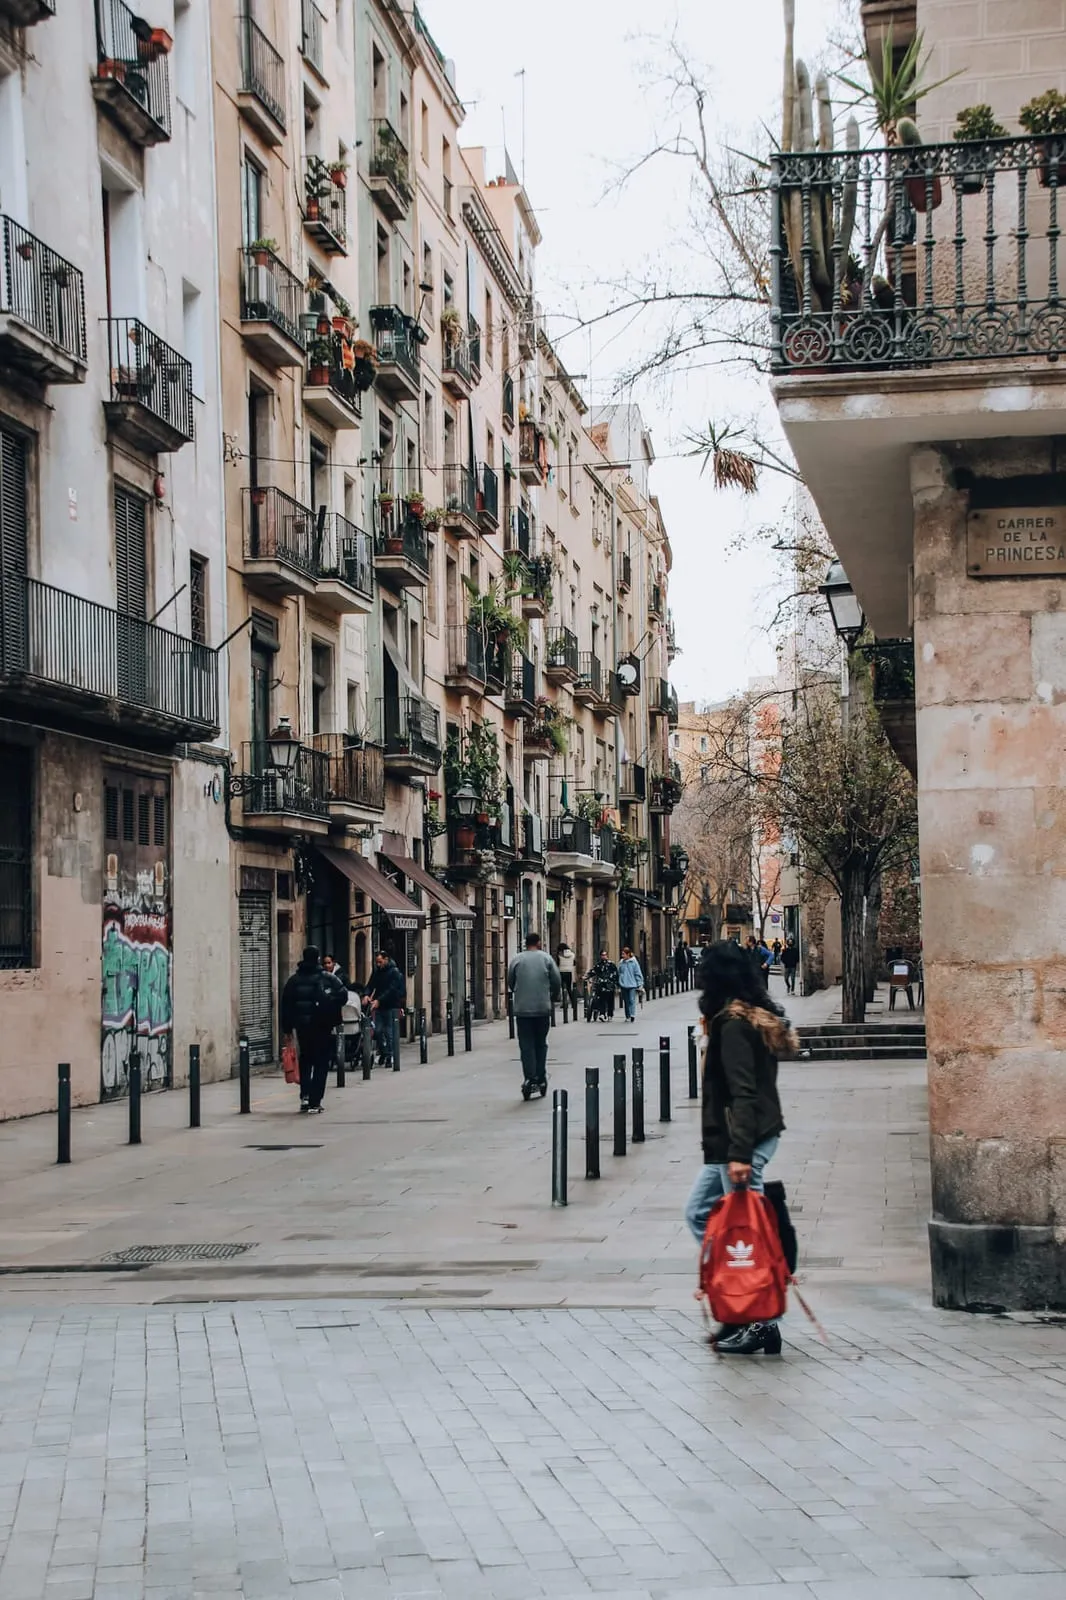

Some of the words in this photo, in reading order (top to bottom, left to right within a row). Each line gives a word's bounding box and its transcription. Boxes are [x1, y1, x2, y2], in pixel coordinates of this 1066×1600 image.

[997, 517, 1055, 529] CARRER
[1003, 532, 1022, 542] DE
[1029, 532, 1047, 541] LA
[986, 546, 1065, 562] PRINCESA
